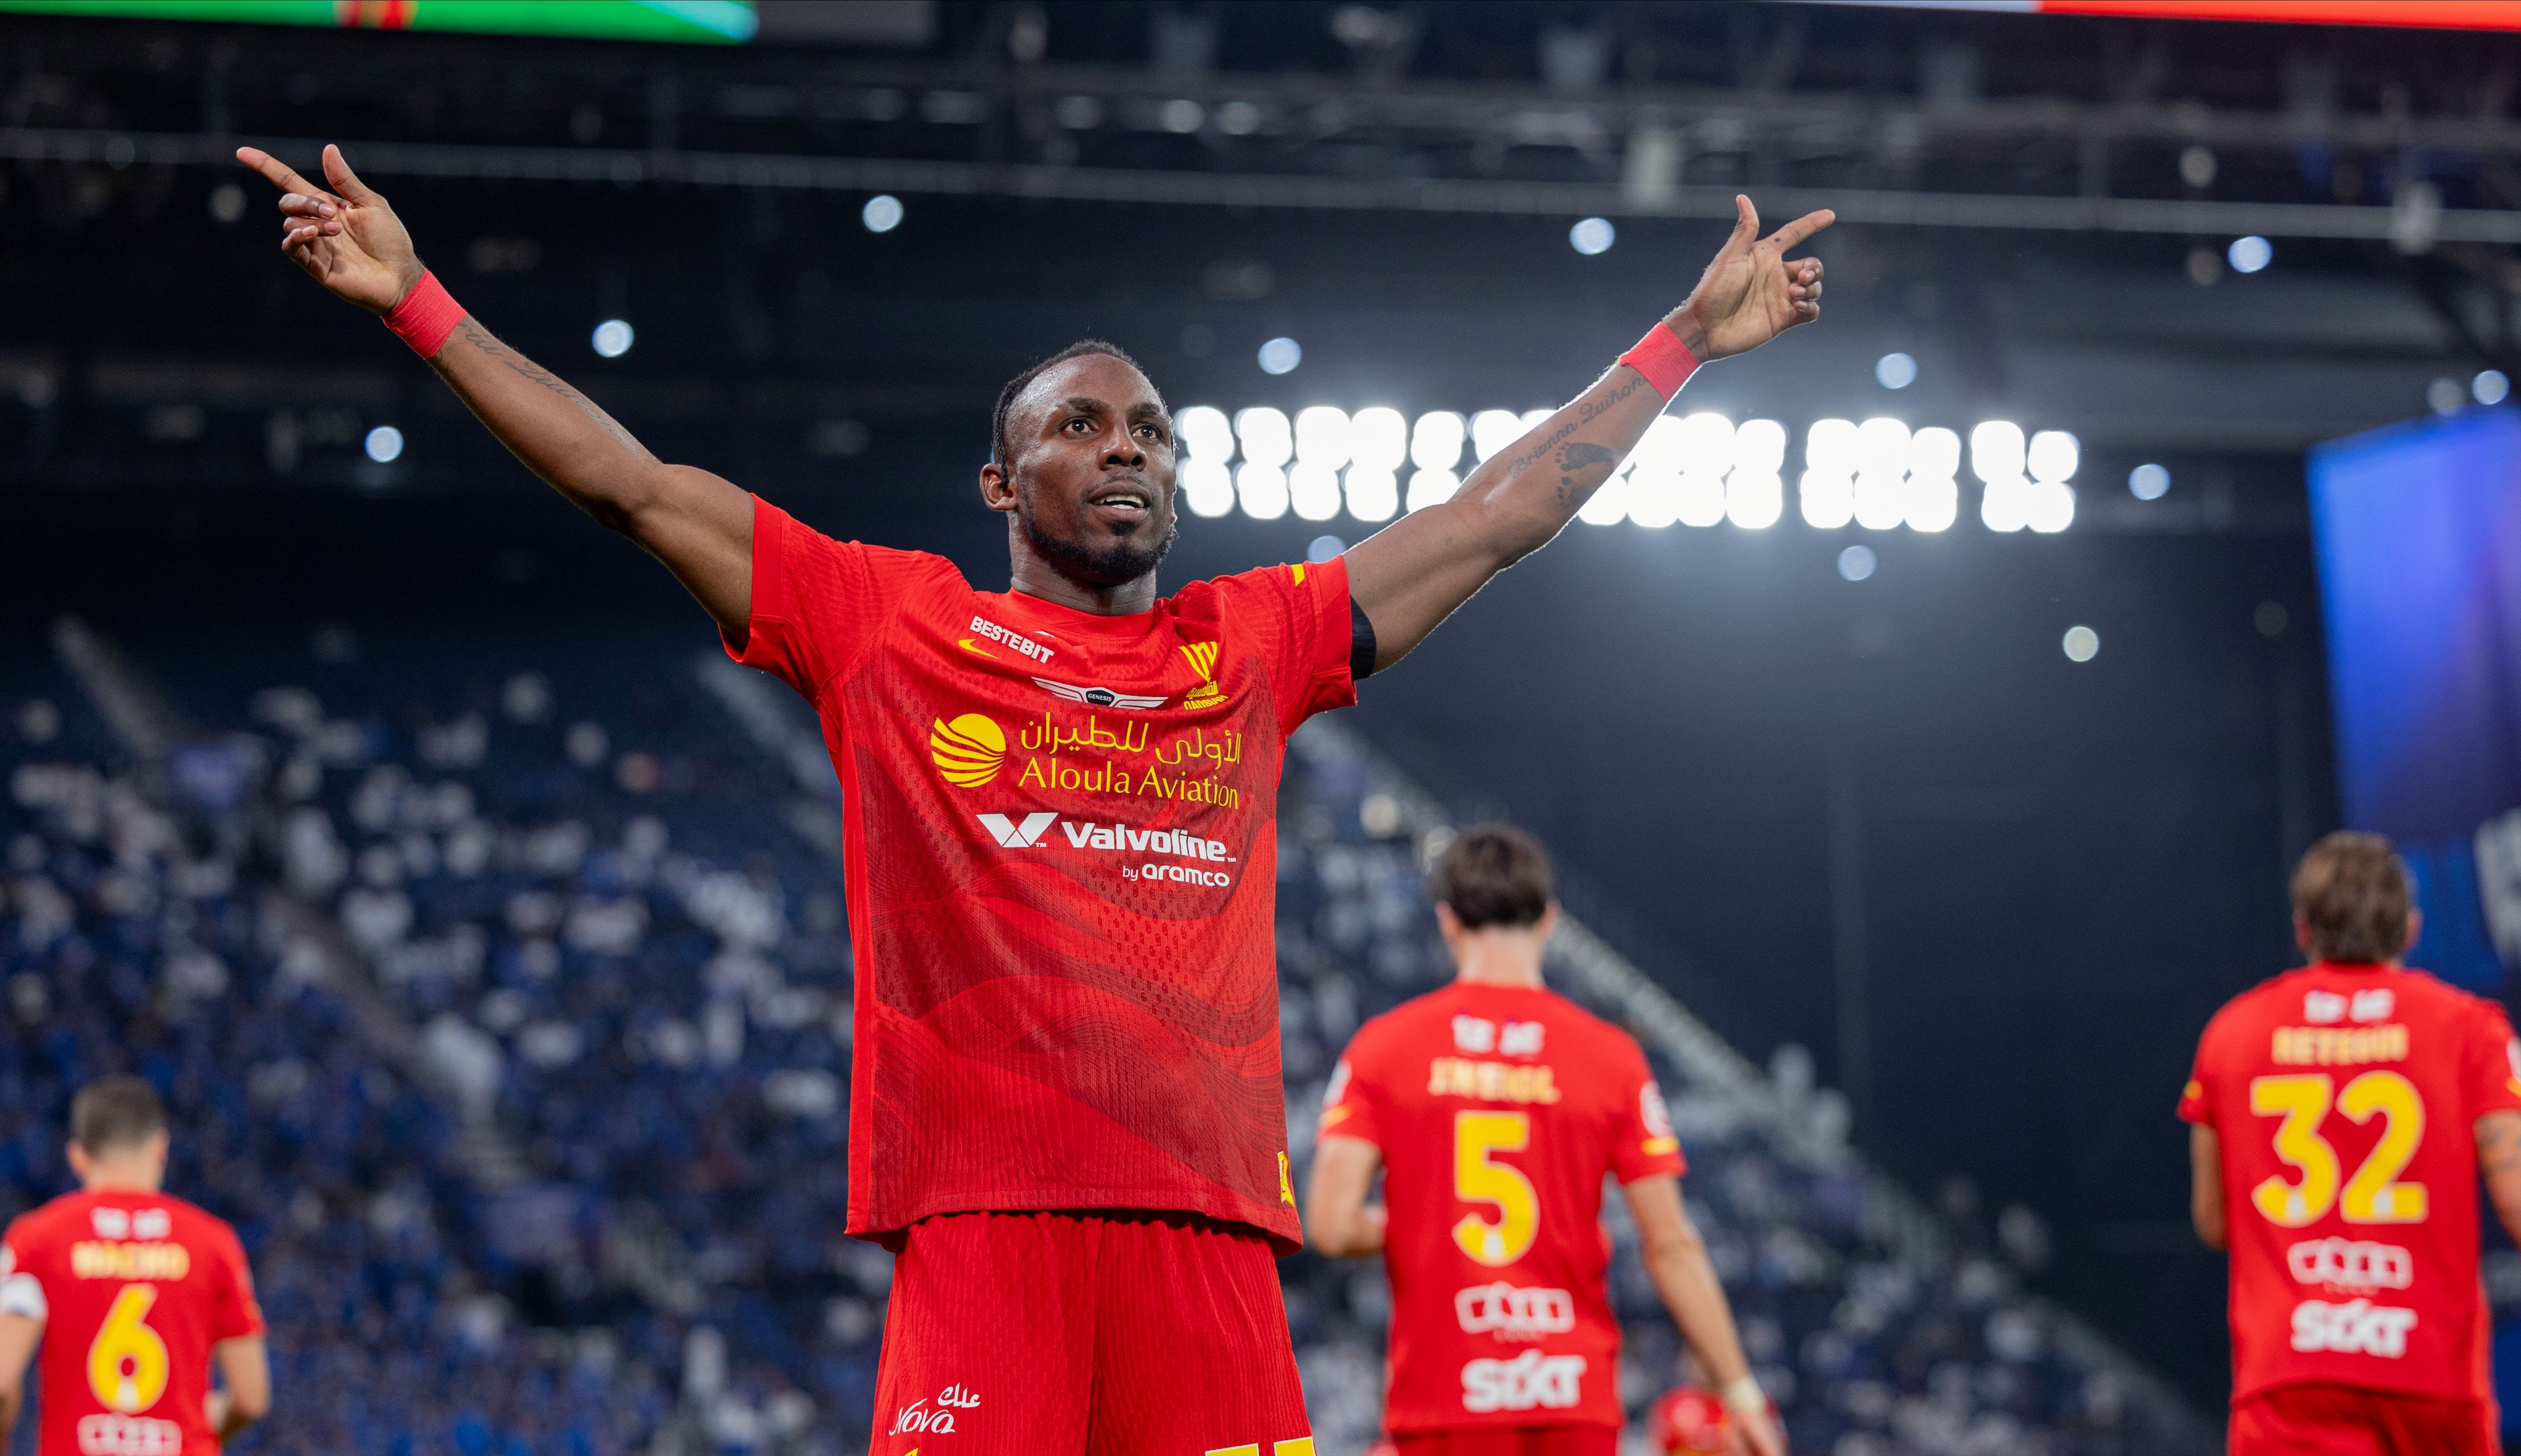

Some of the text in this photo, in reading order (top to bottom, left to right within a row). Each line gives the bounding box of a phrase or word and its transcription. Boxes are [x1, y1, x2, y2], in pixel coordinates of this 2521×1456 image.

[970, 616, 1055, 664] BESTEBIT
[1021, 712, 1242, 770] الأولى للطيران
[1019, 757, 1239, 809] Aloula Aviation
[1061, 821, 1226, 862] Valvoline
[1123, 863, 1230, 887] by aramco
[2250, 1070, 2429, 1228] 32
[1452, 1109, 1540, 1267] 5
[87, 1283, 170, 1414] 6
